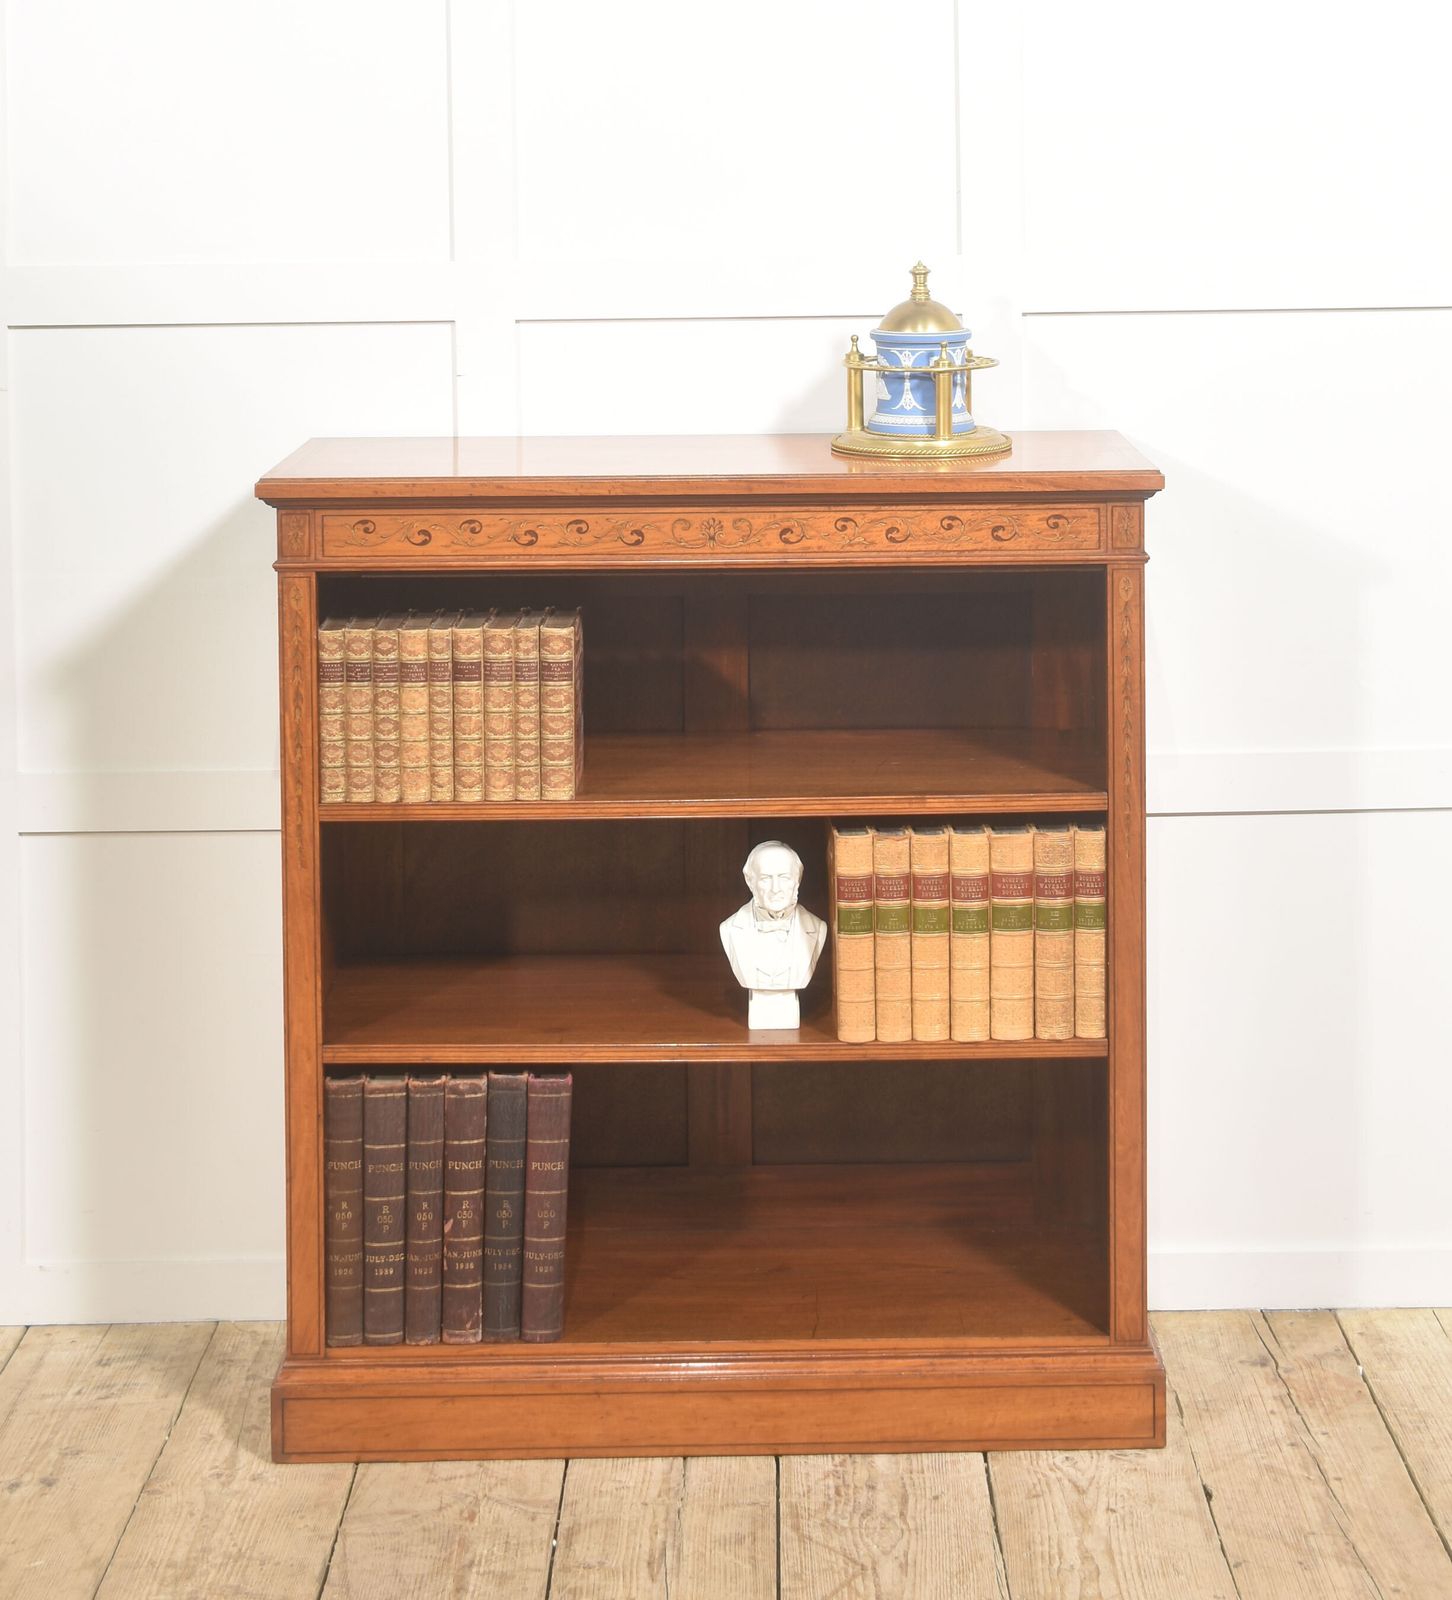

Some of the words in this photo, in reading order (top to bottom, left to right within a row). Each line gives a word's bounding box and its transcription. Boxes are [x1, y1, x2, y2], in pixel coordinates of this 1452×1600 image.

[328, 1160, 362, 1170] PUNCH
[368, 1163, 404, 1173] PUNCH
[409, 1159, 442, 1170] PUNCH
[448, 1160, 483, 1170] PUNCH
[489, 1159, 524, 1169] PUNCH
[531, 1161, 565, 1171] PUNCH
[342, 1201, 348, 1209] R
[382, 1205, 389, 1214] R
[422, 1202, 428, 1210] R
[463, 1200, 470, 1209] R
[416, 1211, 433, 1221] 050
[457, 1210, 473, 1219] 050
